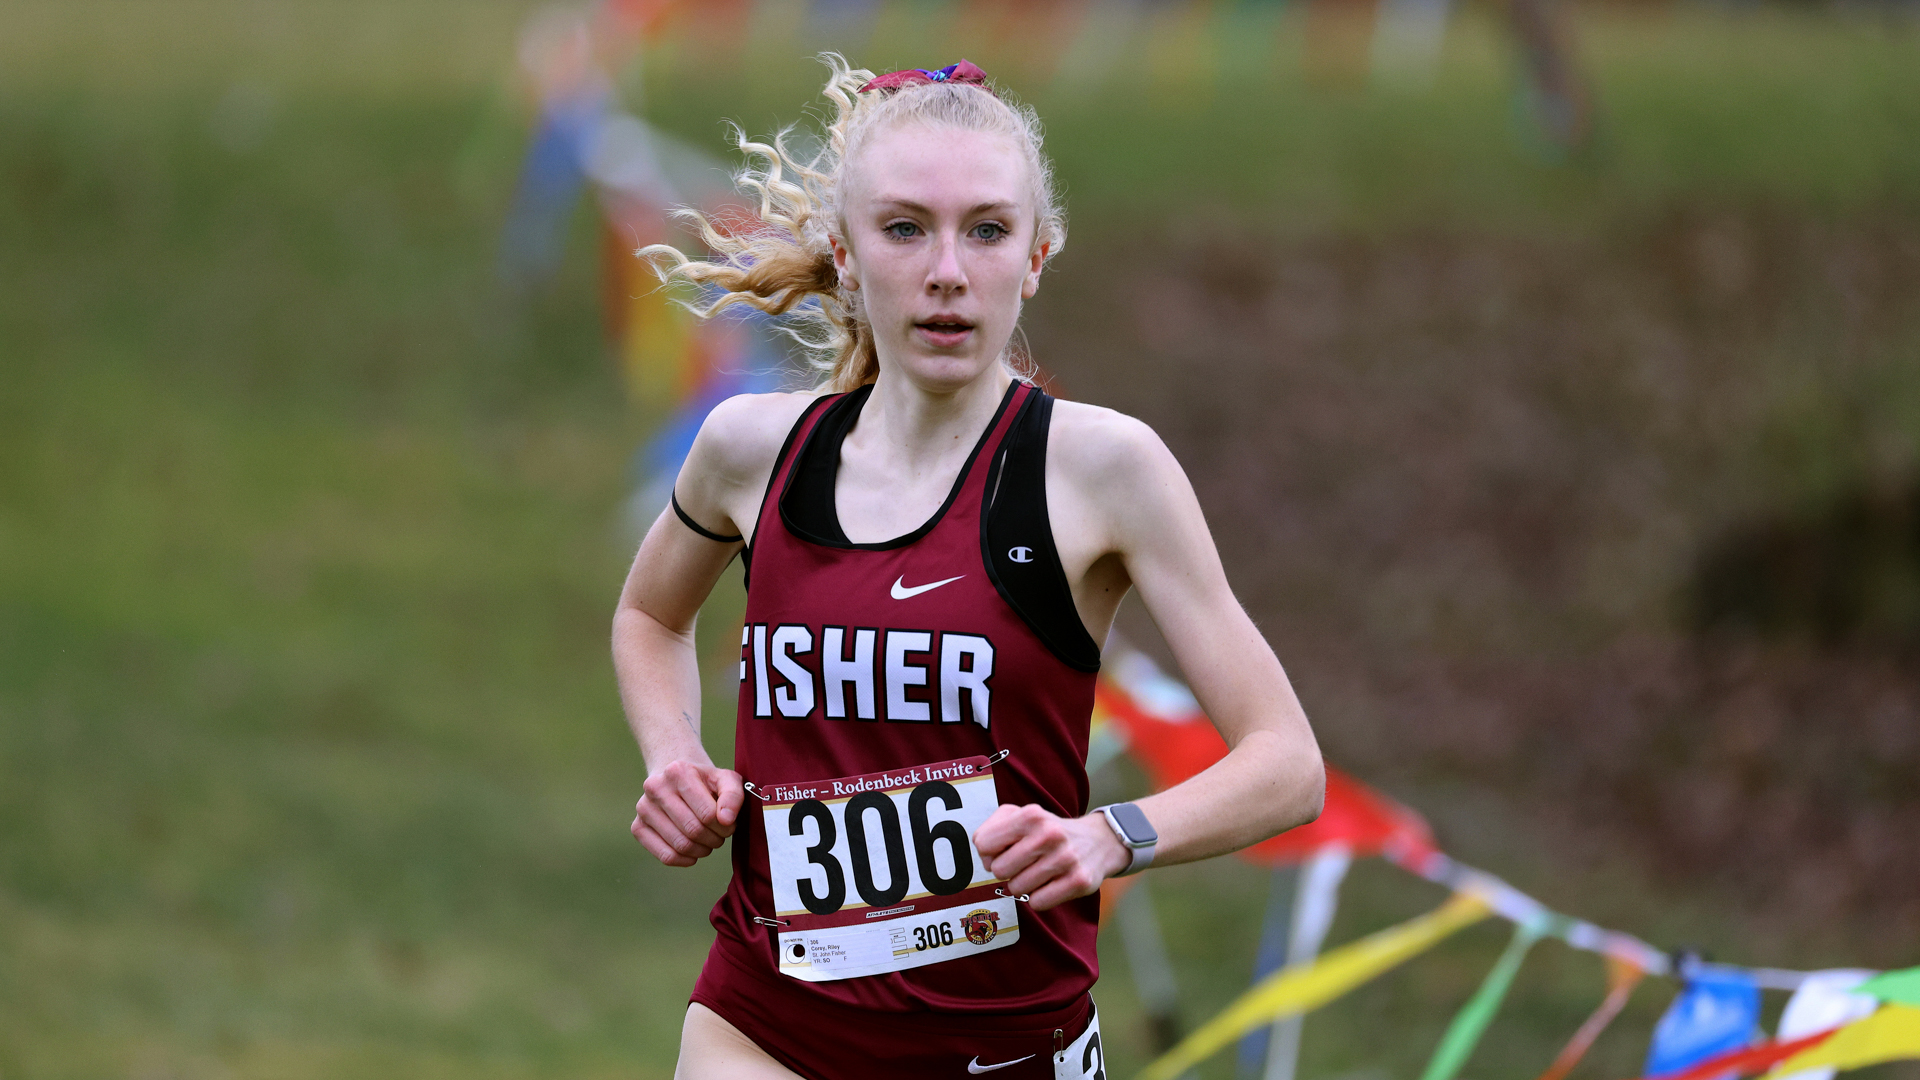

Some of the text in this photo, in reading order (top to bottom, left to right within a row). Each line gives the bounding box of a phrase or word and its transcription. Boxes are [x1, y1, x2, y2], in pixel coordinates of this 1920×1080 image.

[775, 786, 818, 802] Fisher
[832, 770, 922, 796] Rodenbeck
[924, 762, 974, 782] Invite
[788, 780, 974, 915] 306
[913, 922, 954, 951] 306
